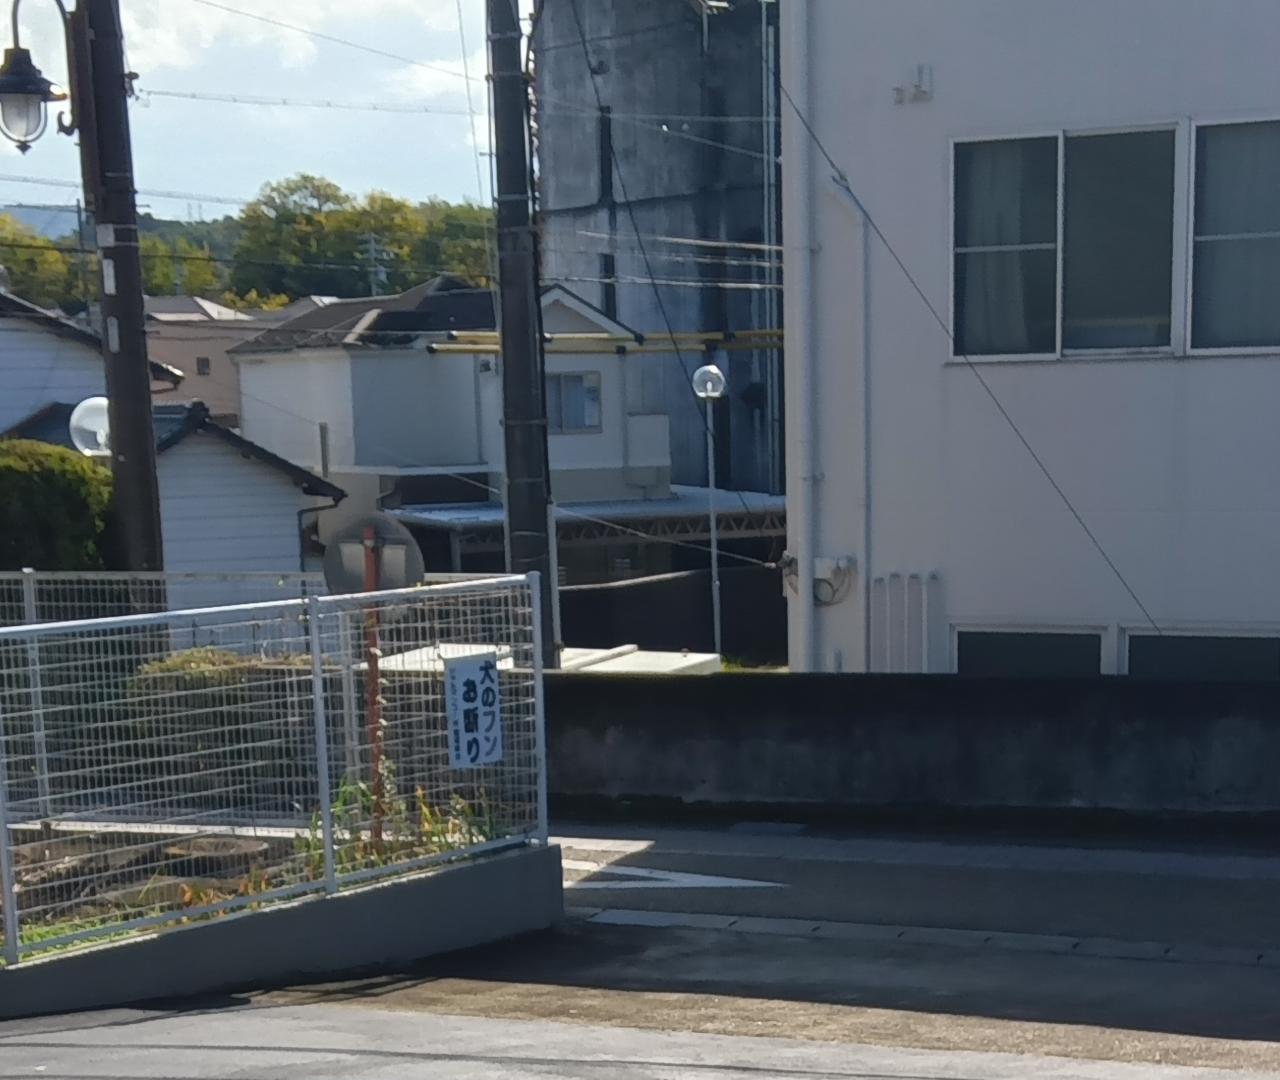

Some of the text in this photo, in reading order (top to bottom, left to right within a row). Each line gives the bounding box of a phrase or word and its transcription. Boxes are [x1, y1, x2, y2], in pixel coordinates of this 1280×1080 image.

[462, 678, 479, 763] お断り
[479, 660, 497, 757] 犬のフン
